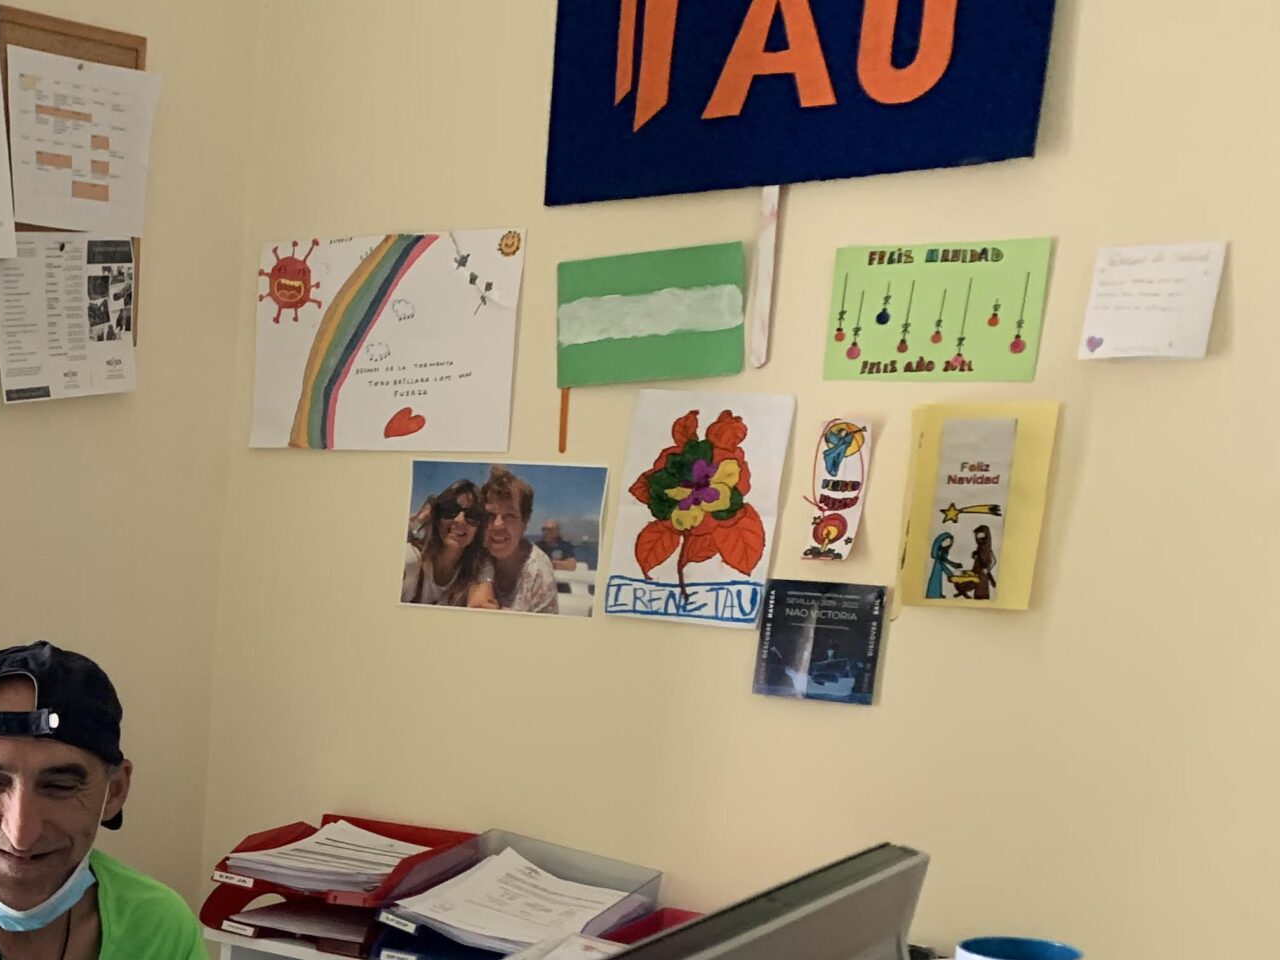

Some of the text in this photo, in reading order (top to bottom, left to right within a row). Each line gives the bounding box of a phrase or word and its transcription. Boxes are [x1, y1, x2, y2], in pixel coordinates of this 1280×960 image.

[925, 247, 1004, 264] NAVIDAD
[960, 461, 990, 472] Feliz
[947, 474, 1000, 485] Navidad
[767, 589, 776, 618] NAVEGA
[785, 608, 858, 620] NAO VICTORIA
